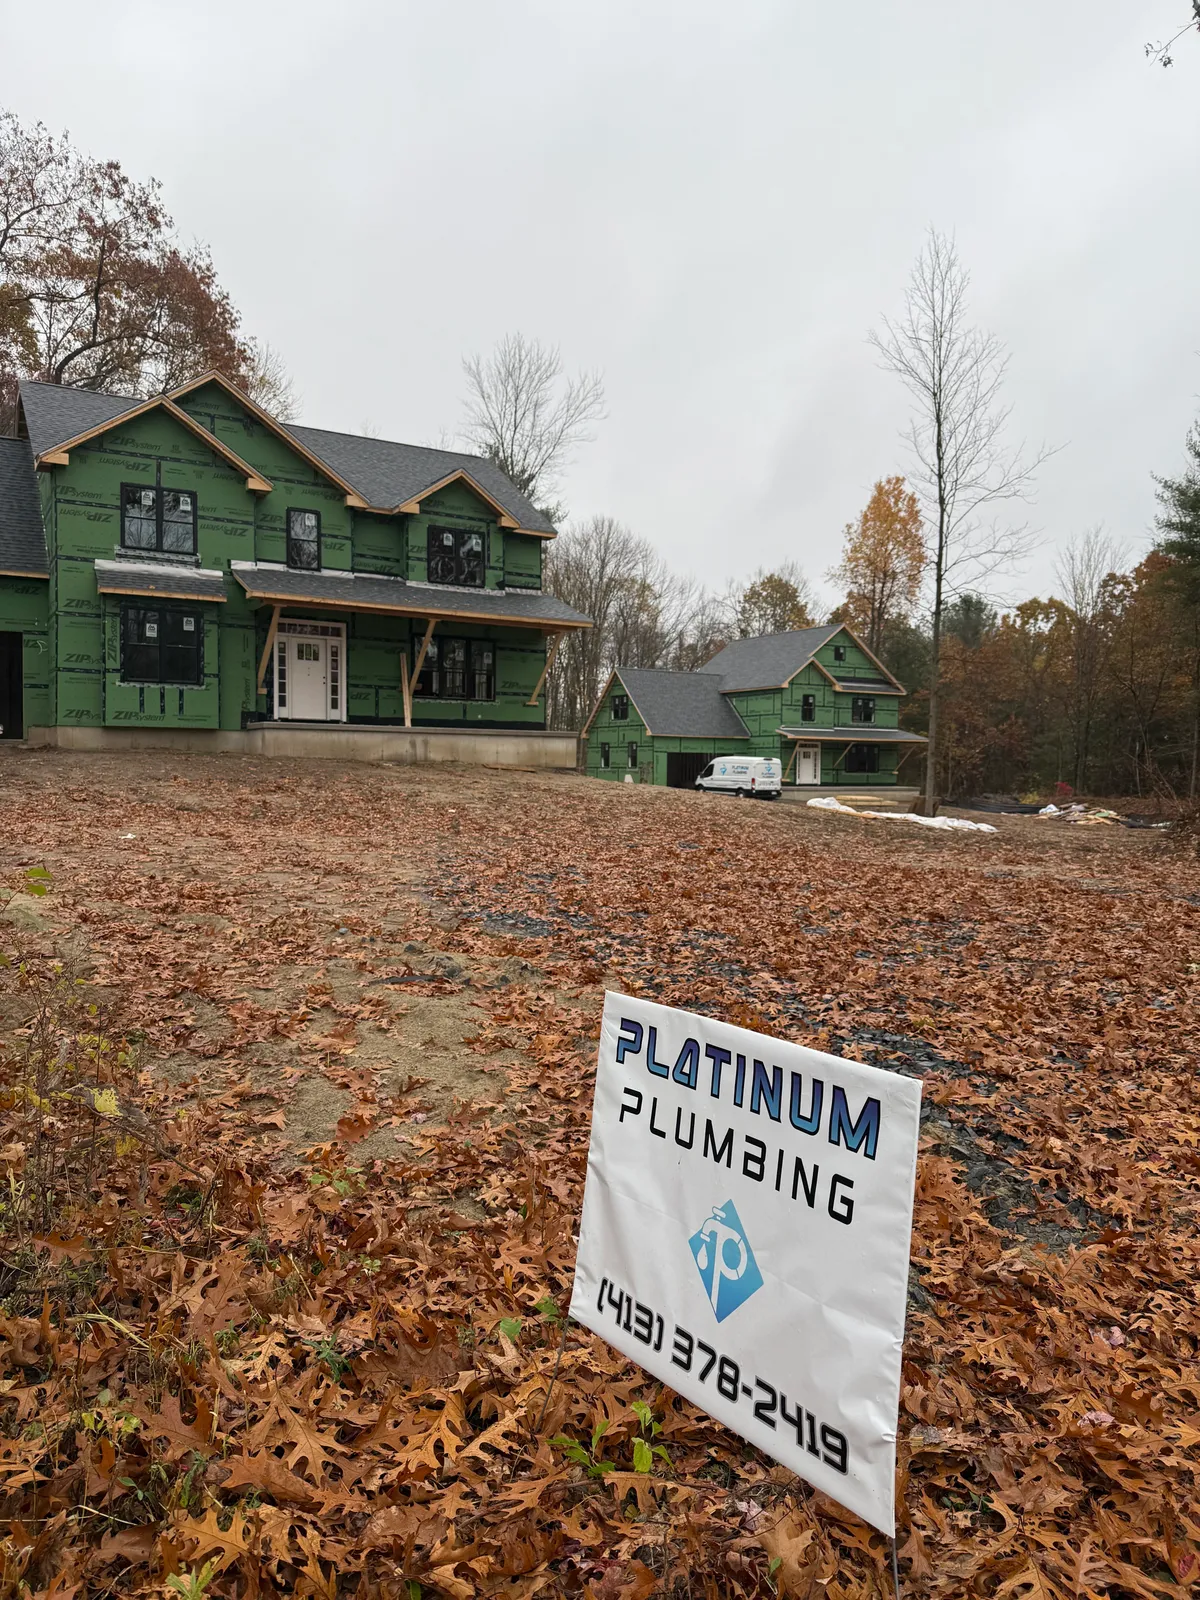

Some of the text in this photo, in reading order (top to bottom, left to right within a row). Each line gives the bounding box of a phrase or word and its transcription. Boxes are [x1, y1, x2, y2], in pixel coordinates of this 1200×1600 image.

[616, 1018, 881, 1160] PLATINUM
[619, 1087, 855, 1225] PLUMBING
[597, 1277, 849, 1475] (413) 378-2419
